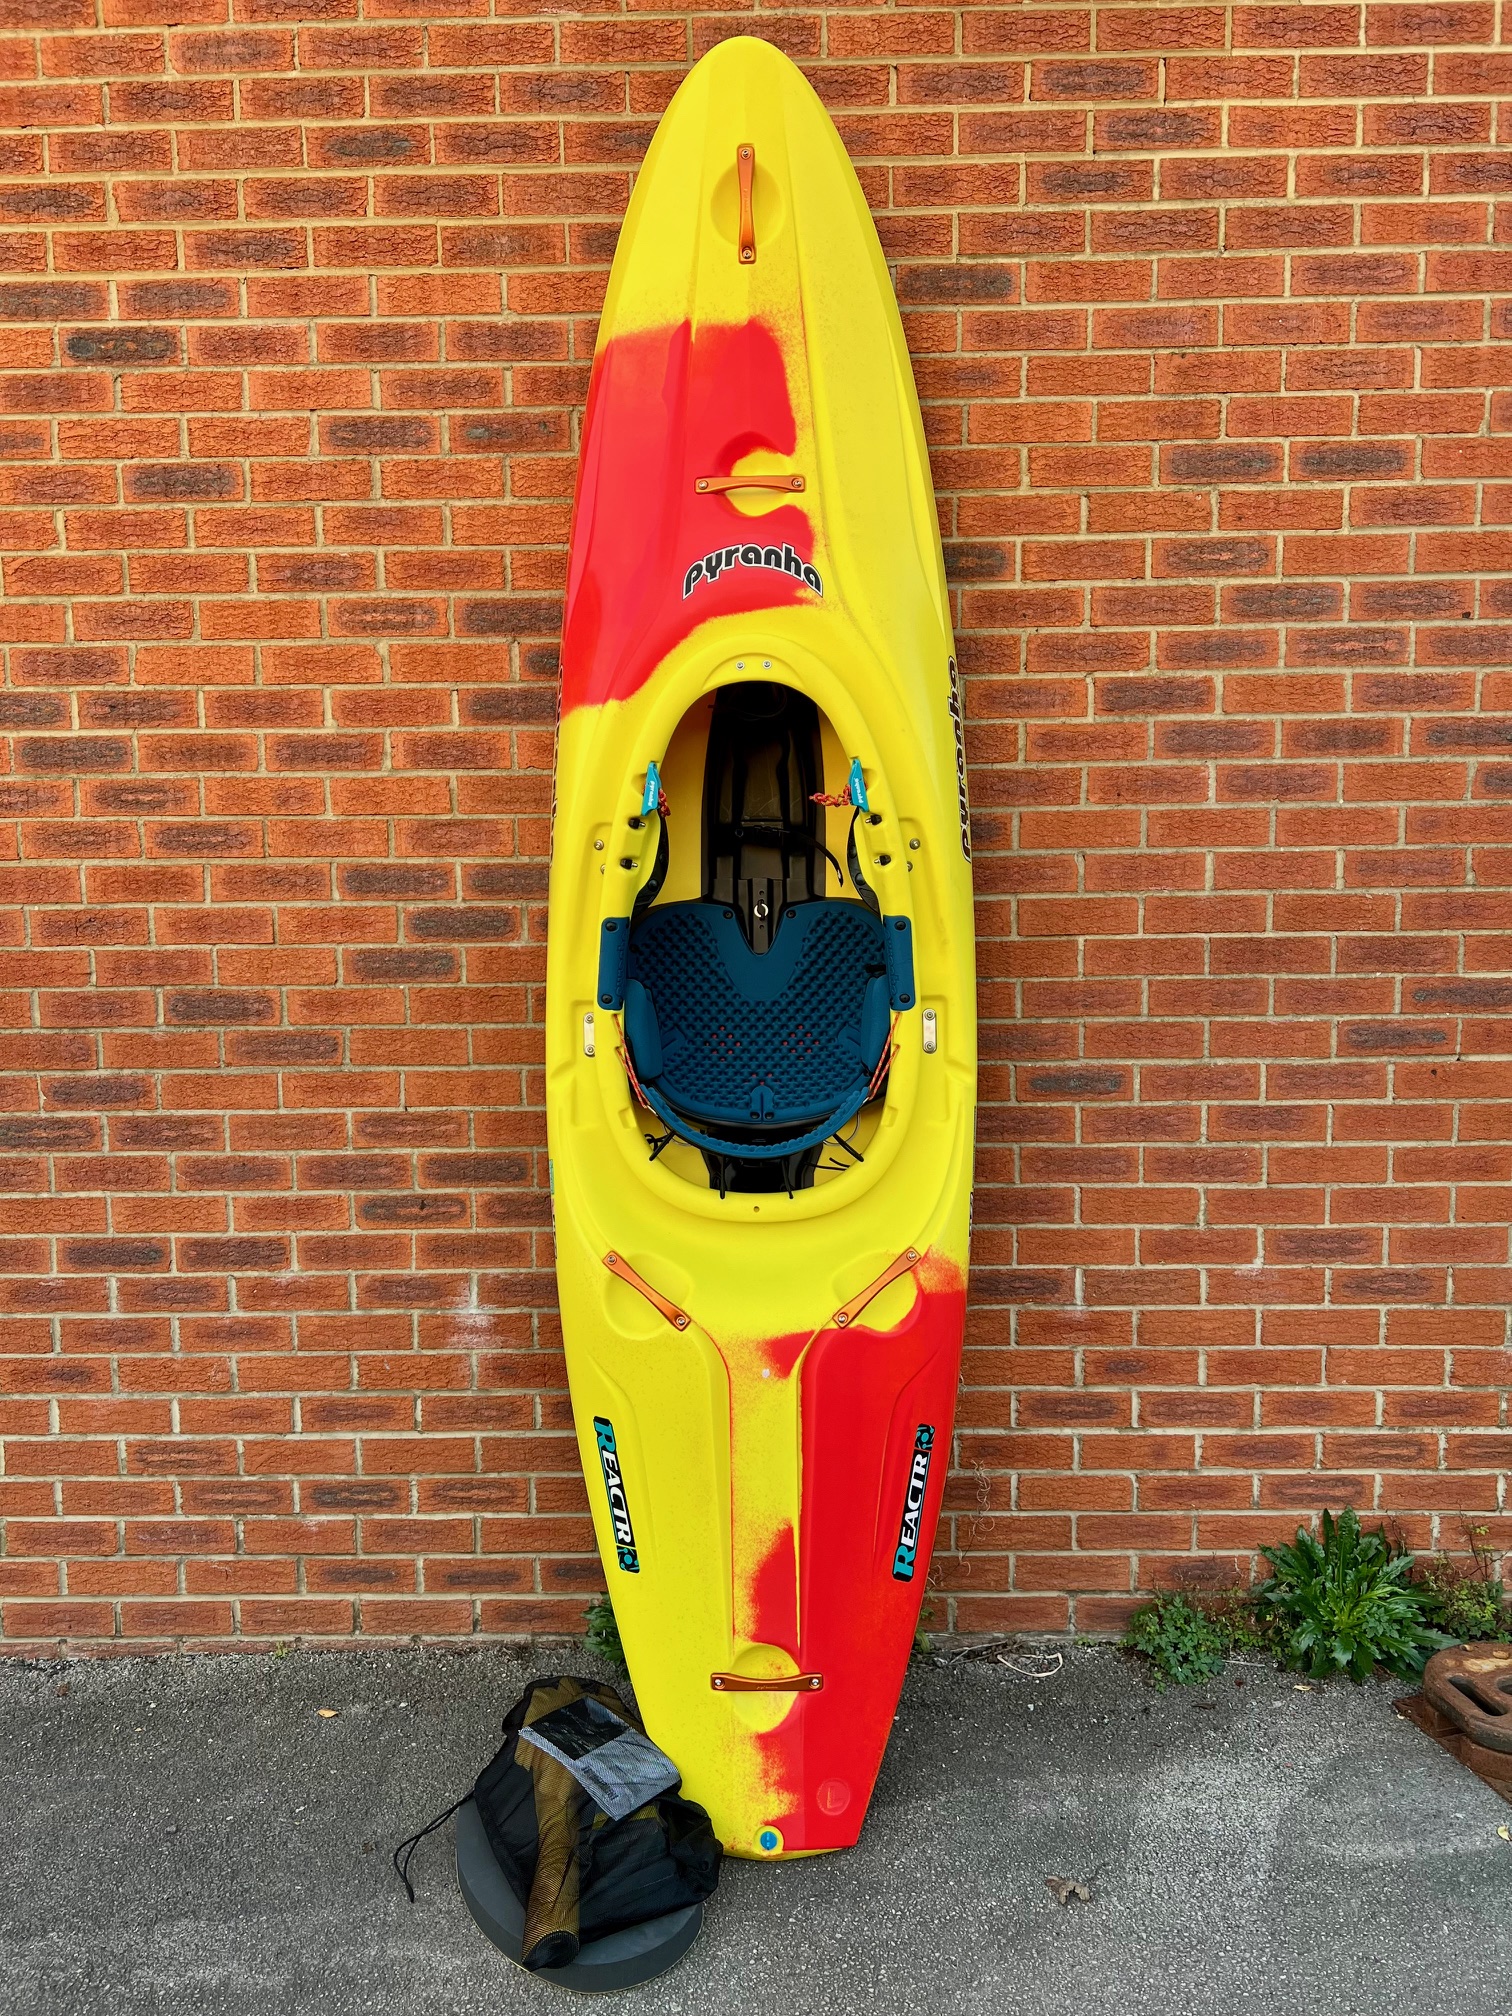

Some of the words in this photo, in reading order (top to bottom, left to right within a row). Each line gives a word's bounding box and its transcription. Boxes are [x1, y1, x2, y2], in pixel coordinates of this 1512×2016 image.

[682, 542, 823, 600] pyranha
[594, 1420, 632, 1544] REACTR
[893, 1453, 928, 1577] REACTR
